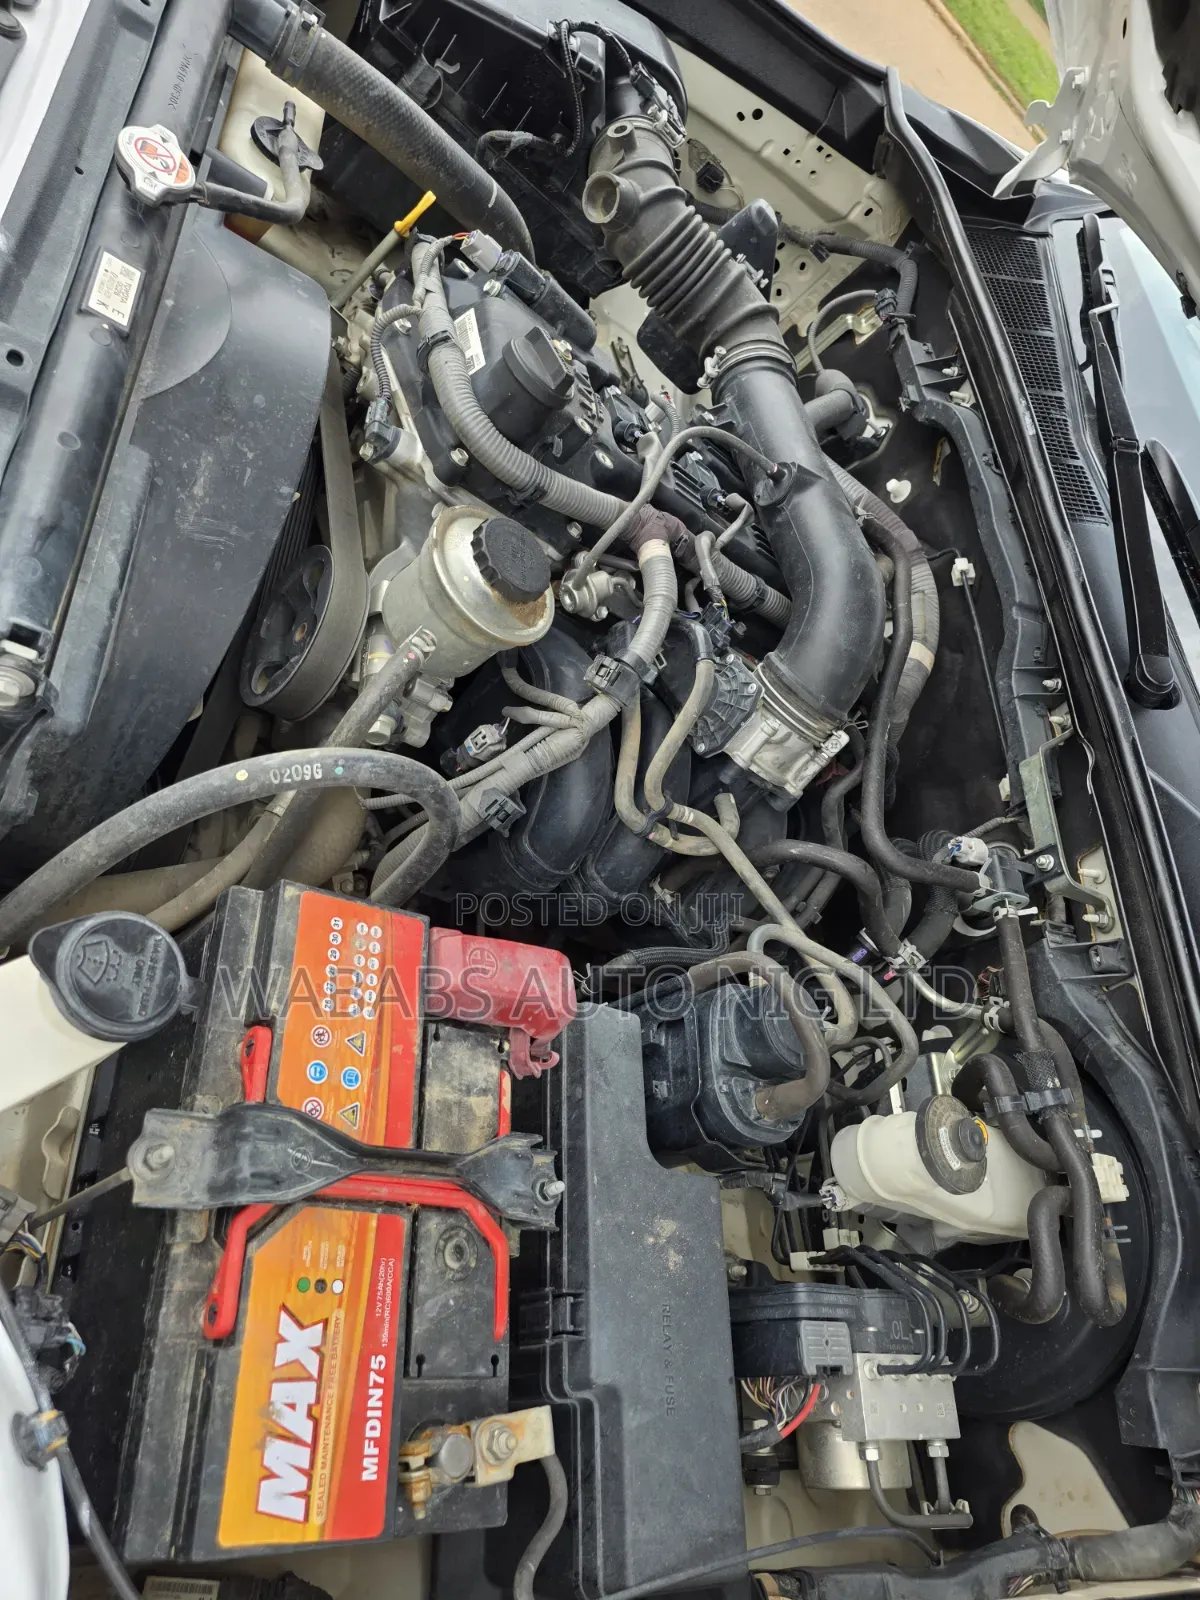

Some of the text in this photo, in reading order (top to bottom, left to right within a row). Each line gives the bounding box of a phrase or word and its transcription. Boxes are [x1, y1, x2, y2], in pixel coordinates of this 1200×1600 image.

[120, 282, 132, 304] TOYOTA
[270, 763, 322, 784] 0209G
[333, 918, 340, 929] 31
[331, 934, 339, 944] 30
[330, 949, 337, 960] 29
[326, 982, 333, 993] 27
[375, 1301, 383, 1317] 12V
[662, 1303, 676, 1417] RELAY & FUSE
[256, 1304, 327, 1523] MAX
[316, 1315, 342, 1518] SEALED MAINTENANCE FREE BATTERY
[361, 1354, 386, 1481] MFDIN75
